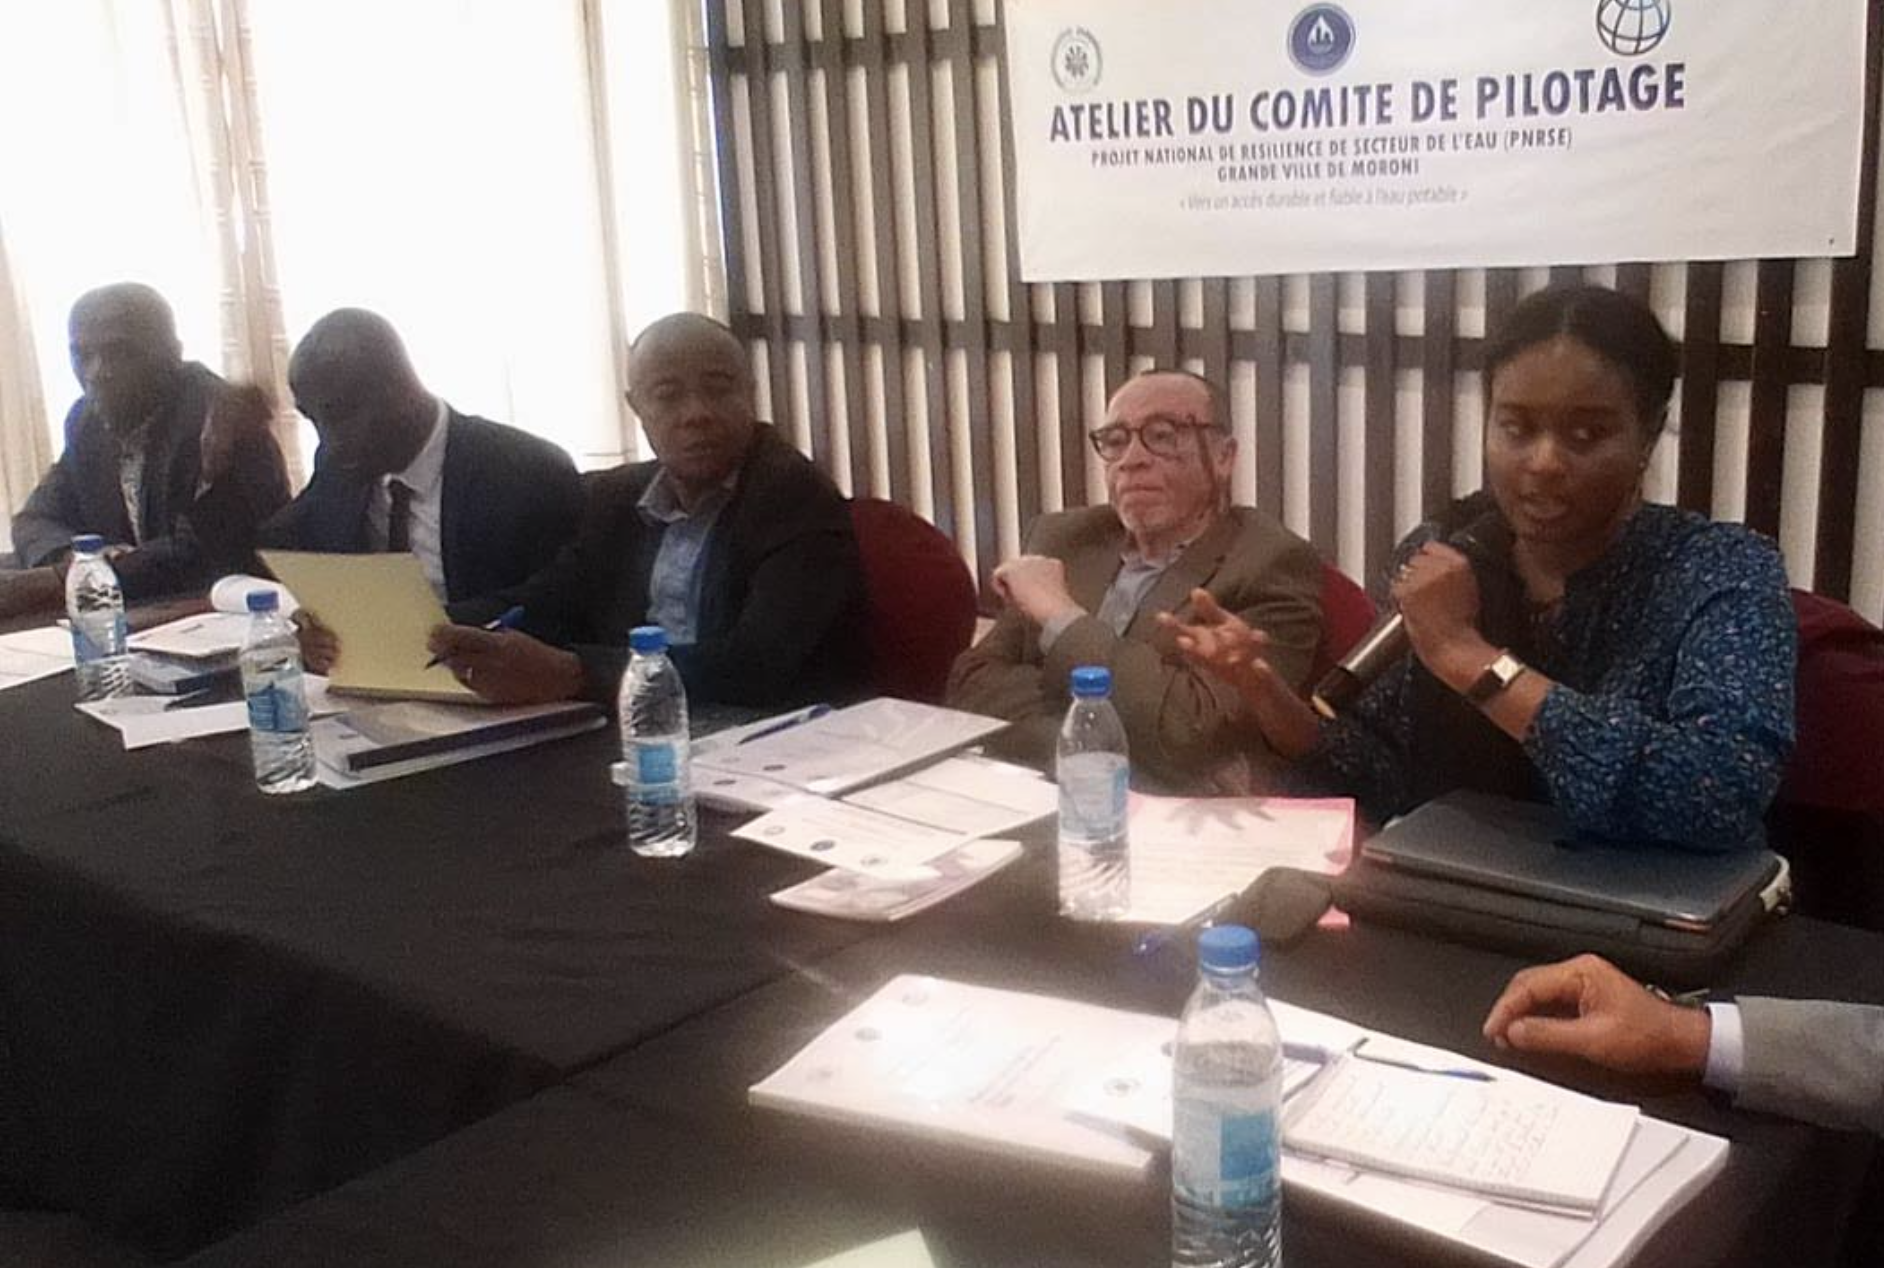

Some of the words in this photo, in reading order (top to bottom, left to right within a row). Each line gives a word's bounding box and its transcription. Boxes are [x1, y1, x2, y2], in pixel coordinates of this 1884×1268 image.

[1050, 99, 1174, 142] ATELIER
[1187, 94, 1234, 135] DU
[1250, 83, 1393, 132] COMITE
[1411, 79, 1458, 123] DE
[1476, 63, 1686, 120] PILOTAGE
[1092, 149, 1139, 168] PROJET
[1145, 146, 1214, 164] NATIONAL
[1219, 145, 1235, 161] DE
[1241, 140, 1323, 160] RESILIENCE
[1330, 139, 1347, 157] DE
[1353, 135, 1420, 155] SECTEUR
[1427, 133, 1446, 152] DE
[1452, 131, 1498, 150] L'EAU
[1504, 127, 1573, 151] (PNRSE)
[1218, 163, 1277, 183] GRANDE
[1282, 162, 1321, 180] VILLE
[1327, 161, 1346, 178] DE
[1351, 158, 1420, 177] MORONI
